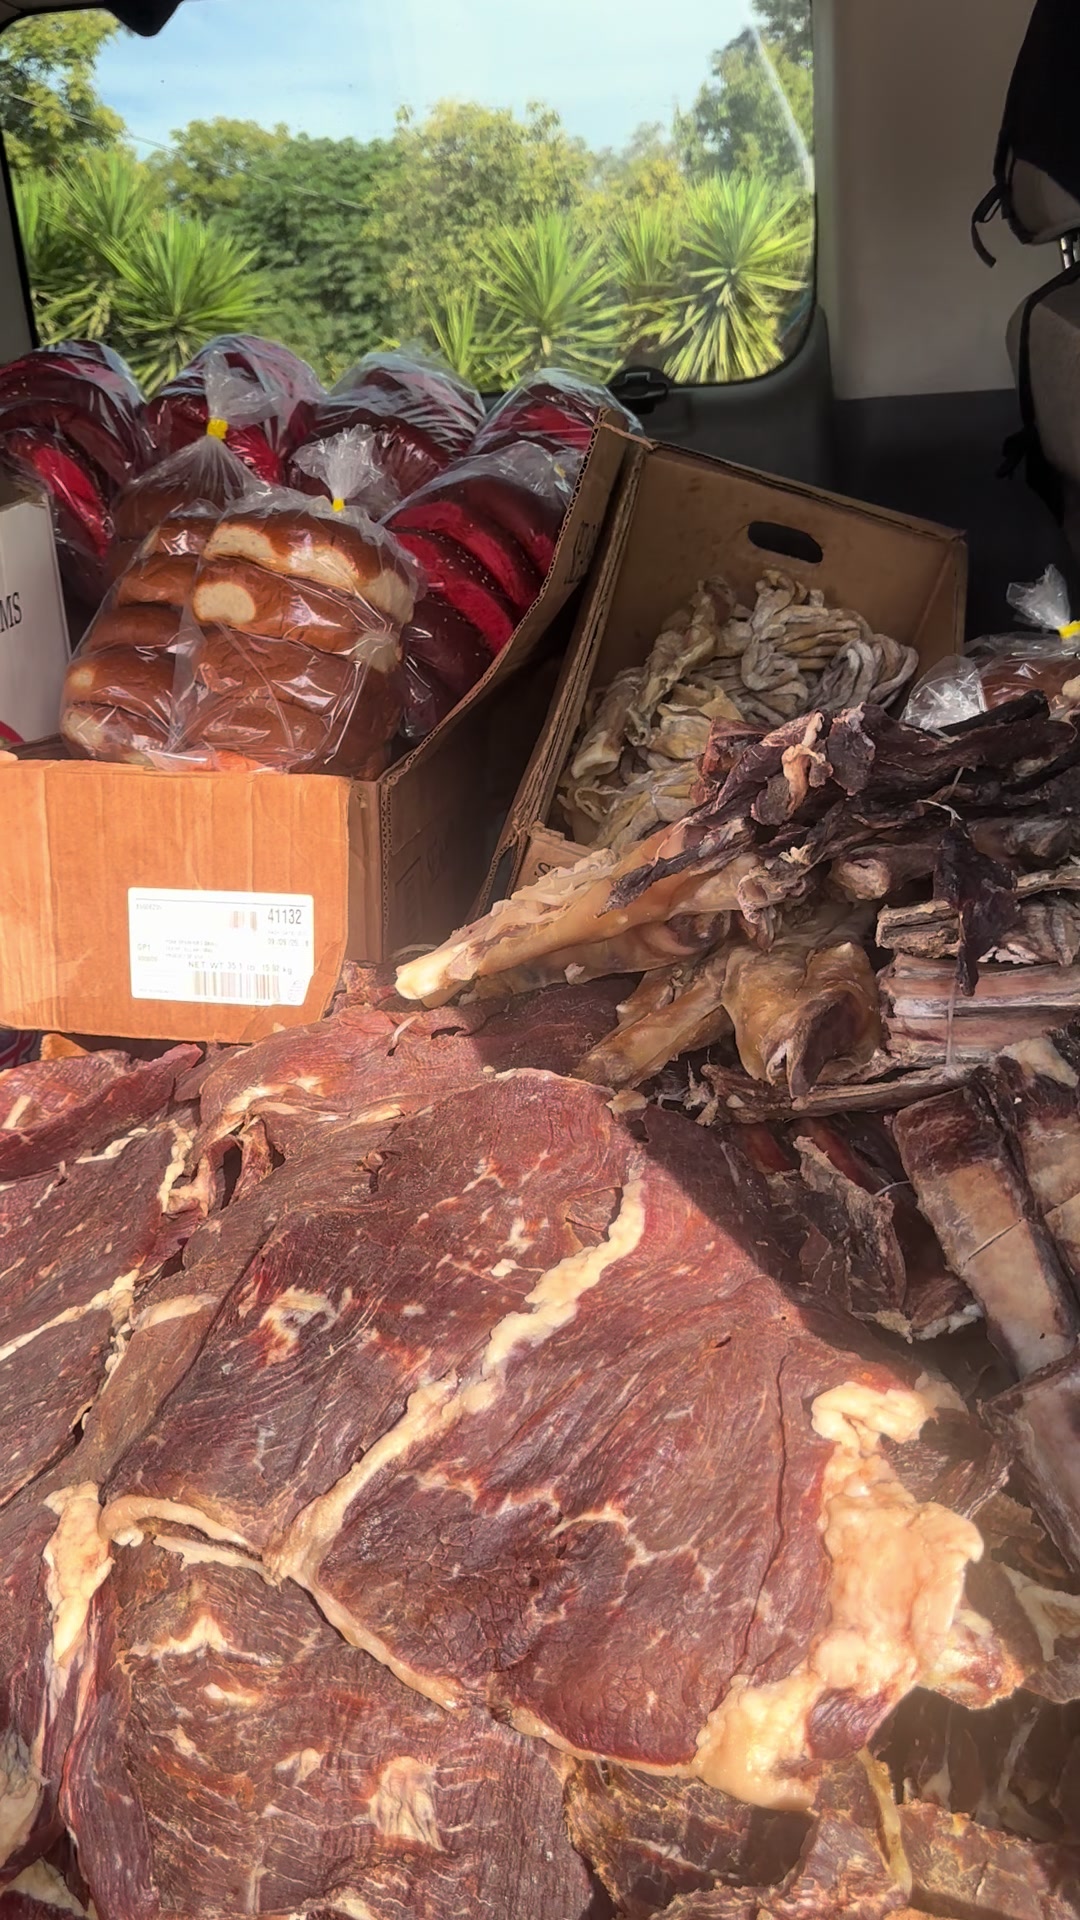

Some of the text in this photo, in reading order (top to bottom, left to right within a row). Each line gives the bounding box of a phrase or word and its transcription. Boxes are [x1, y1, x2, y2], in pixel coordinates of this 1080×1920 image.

[267, 908, 302, 925] 41132
[188, 961, 206, 969] NET
[227, 961, 243, 970] 351
